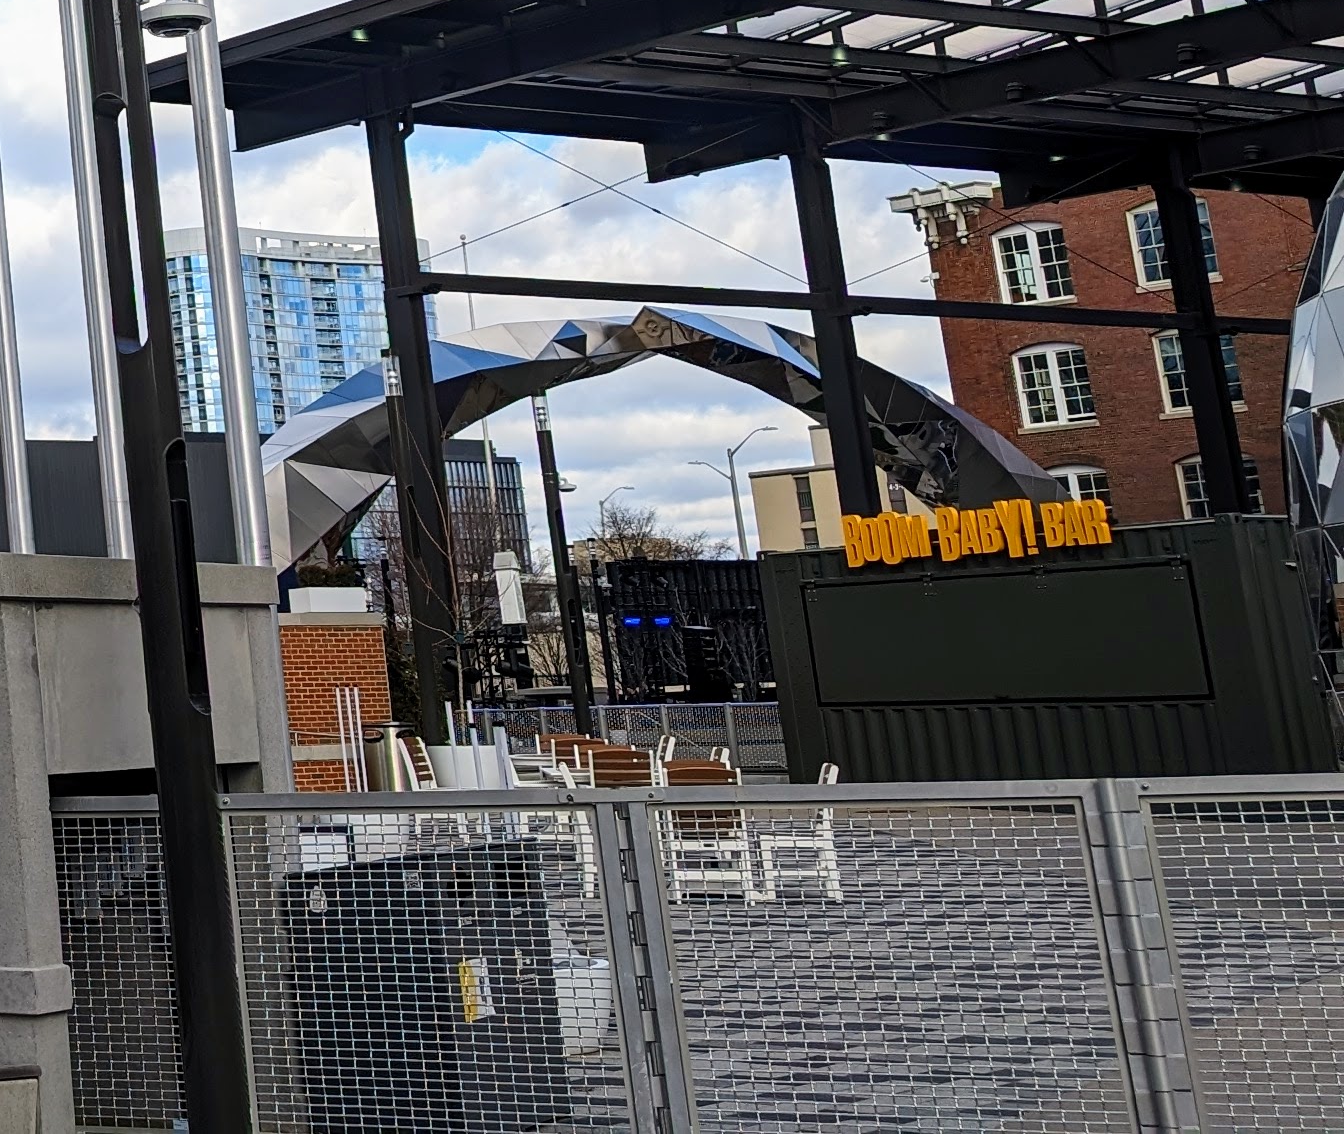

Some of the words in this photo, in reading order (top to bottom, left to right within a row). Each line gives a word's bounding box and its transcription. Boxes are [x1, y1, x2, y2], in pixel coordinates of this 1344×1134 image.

[841, 511, 932, 568] BOOM
[934, 498, 1039, 562] BABY!
[1039, 499, 1112, 548] BAR
